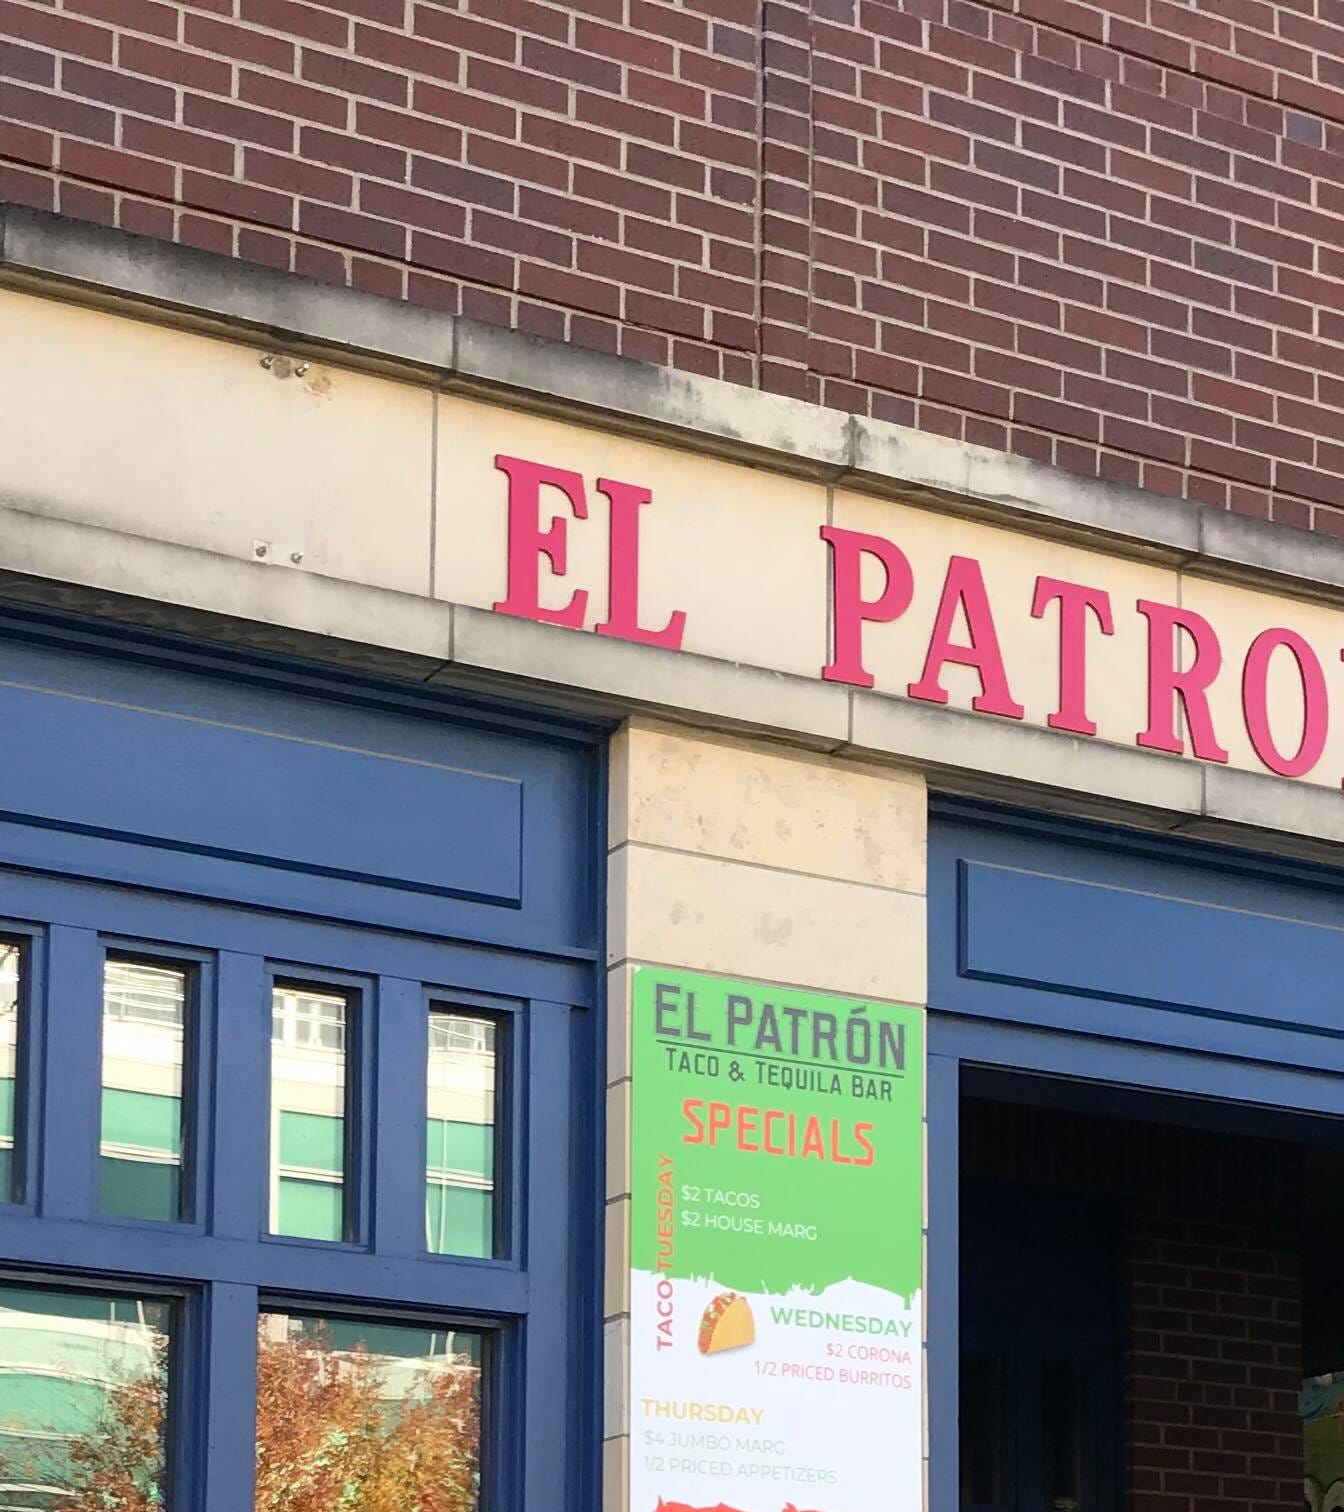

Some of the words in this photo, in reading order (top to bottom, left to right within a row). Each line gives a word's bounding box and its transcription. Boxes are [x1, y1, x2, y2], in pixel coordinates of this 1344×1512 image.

[494, 455, 687, 651] EL
[654, 982, 712, 1042] EL
[726, 993, 905, 1070] PATRÓN
[665, 1047, 720, 1078] TACO
[728, 1061, 746, 1083] &
[755, 1061, 843, 1096] TEQUILA
[851, 1075, 893, 1102] BAR
[681, 1098, 876, 1167] SPECIALS
[657, 1152, 675, 1271] TUESDAY
[680, 1184, 701, 1203] $2
[704, 1188, 761, 1209] TACOS
[680, 1210, 701, 1228] $2
[704, 1214, 764, 1234] HOUSE
[768, 1221, 818, 1241] MARG
[657, 1279, 674, 1351] TACO
[769, 1306, 913, 1338] WEDNESDAY
[825, 1342, 844, 1358] $2
[848, 1344, 912, 1365] CORONA
[754, 1361, 777, 1377] 1/2
[782, 1363, 835, 1382] PRICED
[839, 1366, 912, 1390] BURRITOS
[640, 1398, 766, 1426] THURSDAY
[644, 1430, 665, 1446] $4
[668, 1432, 732, 1451] JUMBO
[735, 1437, 787, 1456] MARG
[669, 1458, 732, 1477] PRICED
[735, 1463, 840, 1486] APPETIZERS
